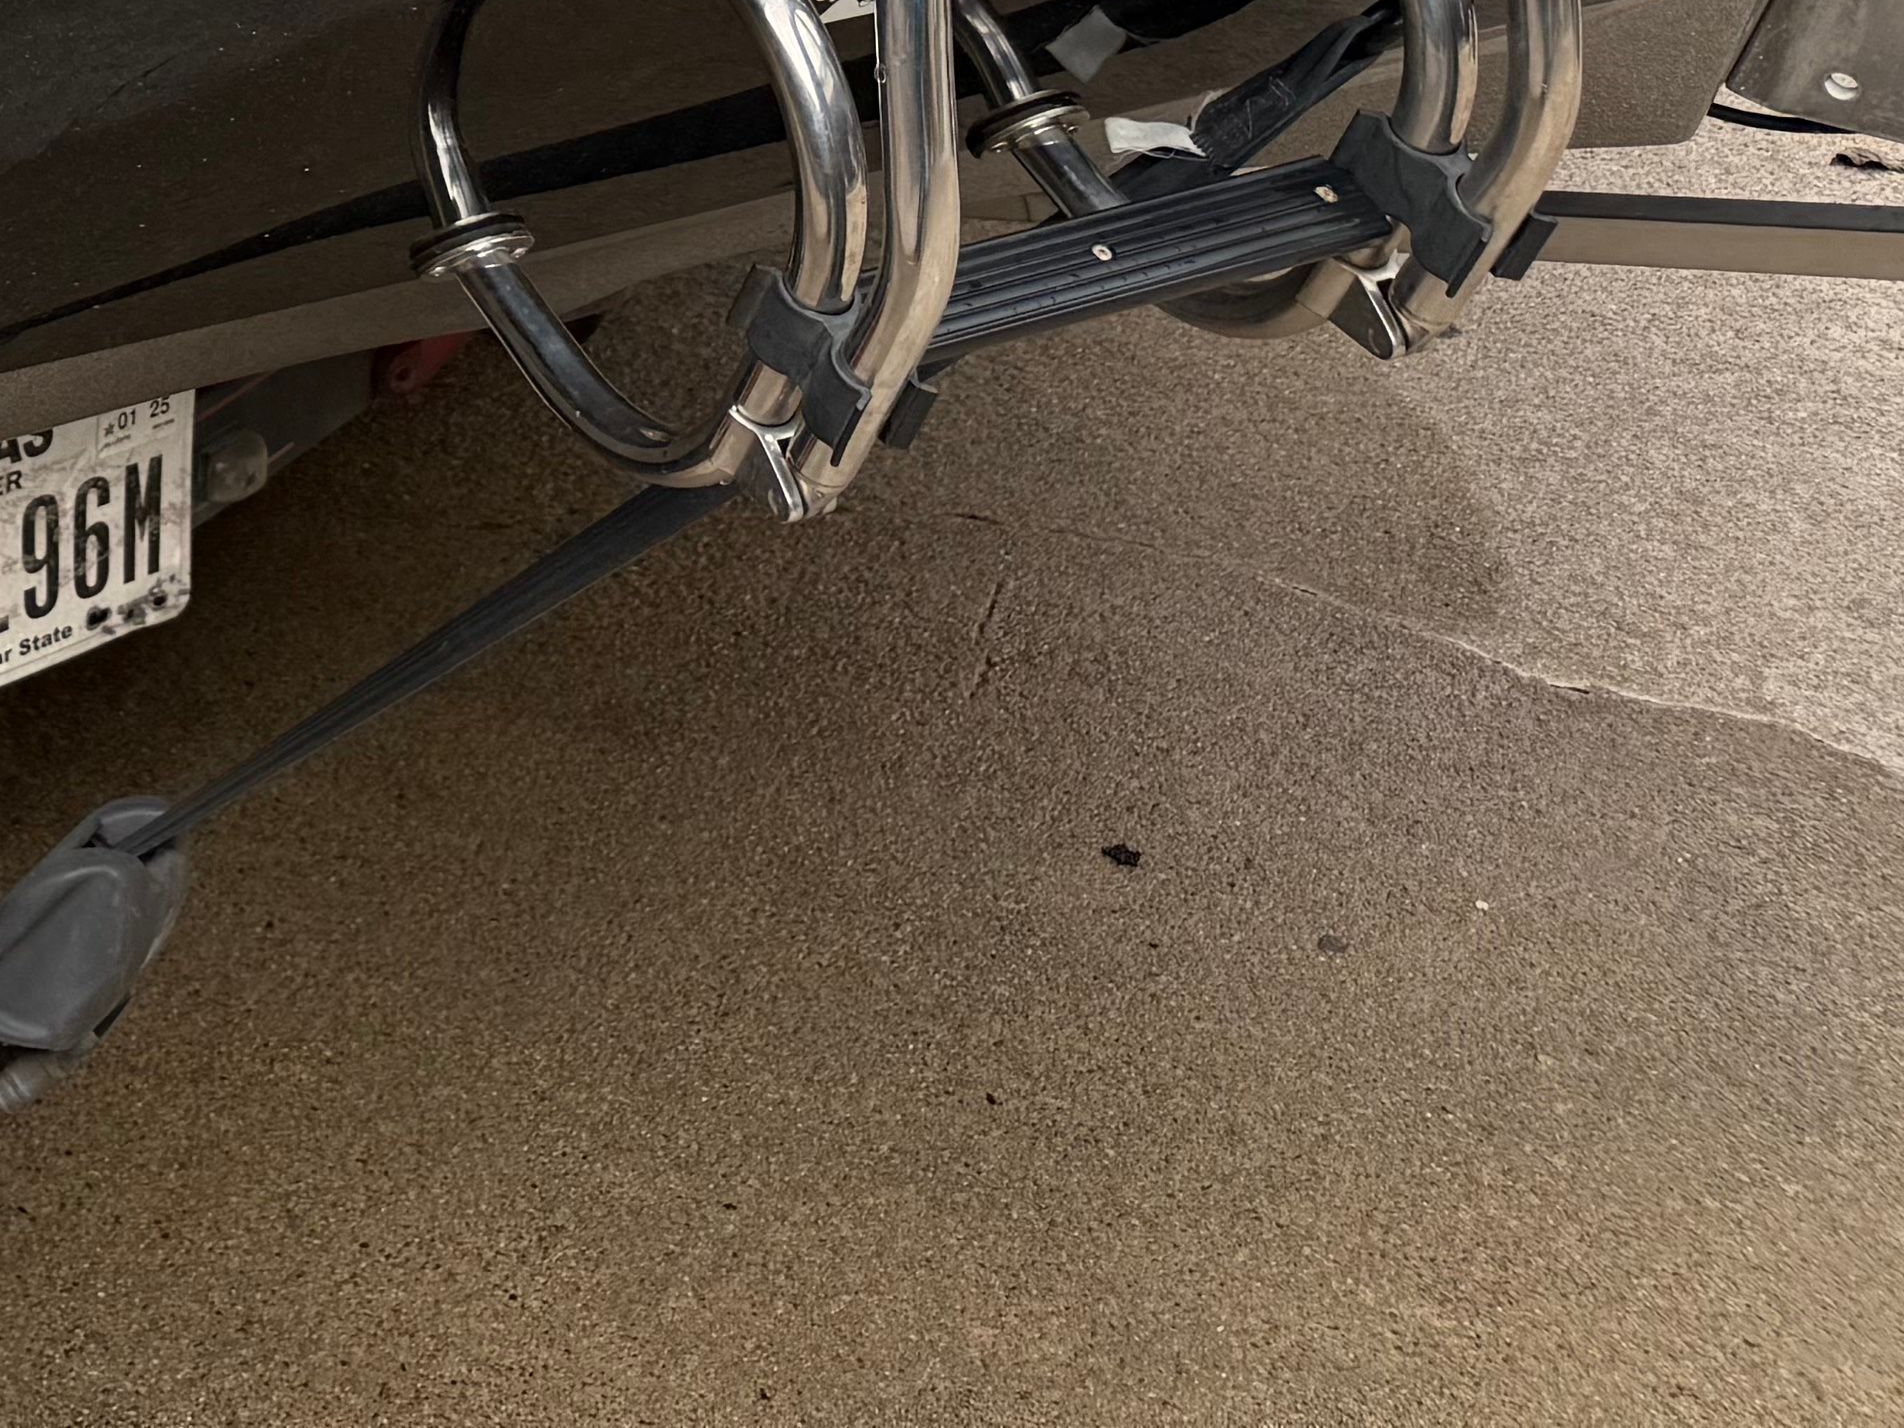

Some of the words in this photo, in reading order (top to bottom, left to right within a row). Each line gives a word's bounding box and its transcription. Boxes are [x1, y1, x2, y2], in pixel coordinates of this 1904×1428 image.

[118, 408, 137, 430] 01
[149, 396, 171, 418] 25
[18, 625, 73, 656] State
